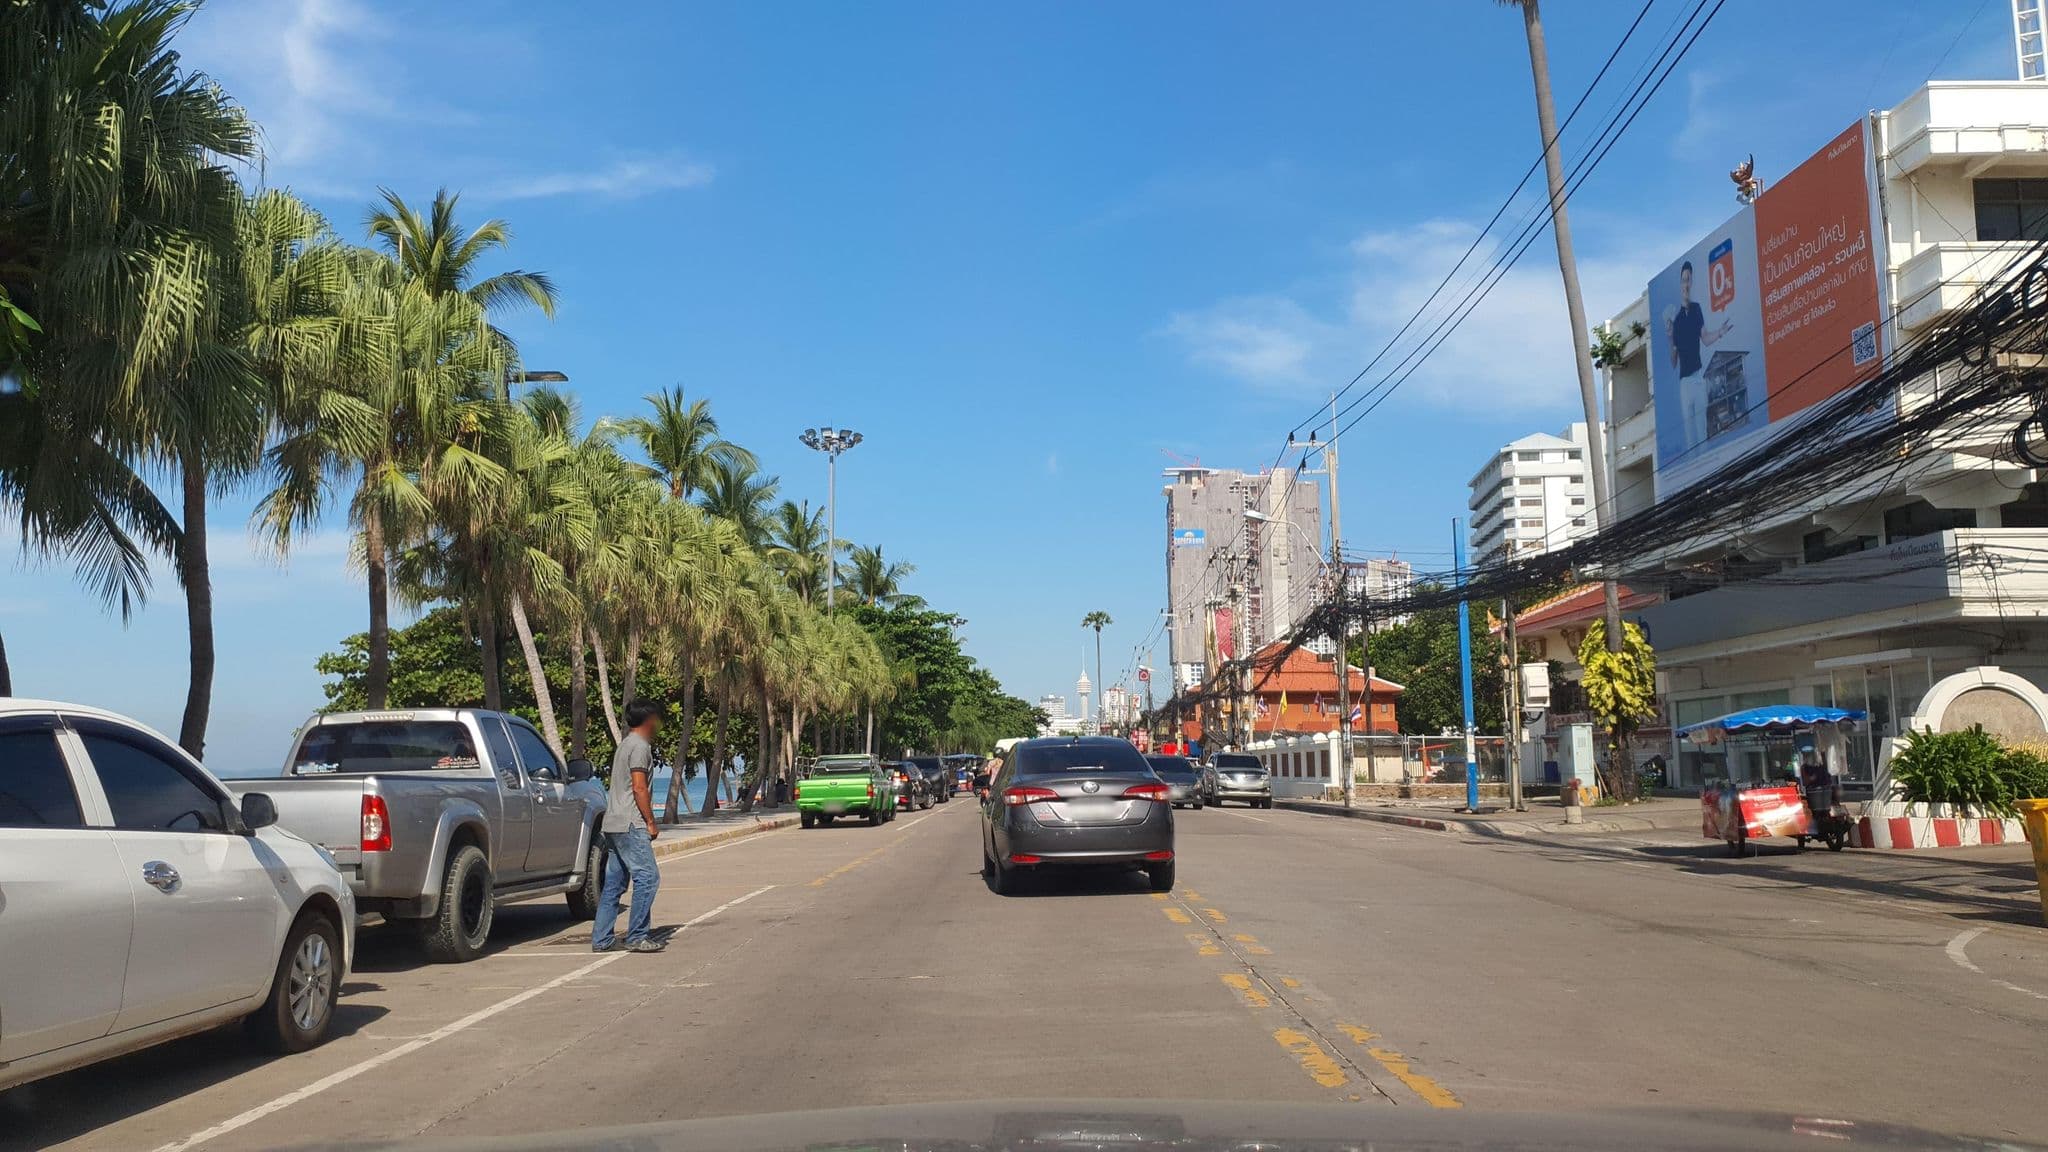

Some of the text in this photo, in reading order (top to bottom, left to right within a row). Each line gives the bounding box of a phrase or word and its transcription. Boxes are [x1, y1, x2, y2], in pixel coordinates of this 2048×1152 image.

[1763, 215, 1847, 285] เป็นเงินก้อนใหญ่
[1765, 262, 1826, 307] เสริมสภาพคล่อง
[1835, 229, 1866, 264] รวบหนี้
